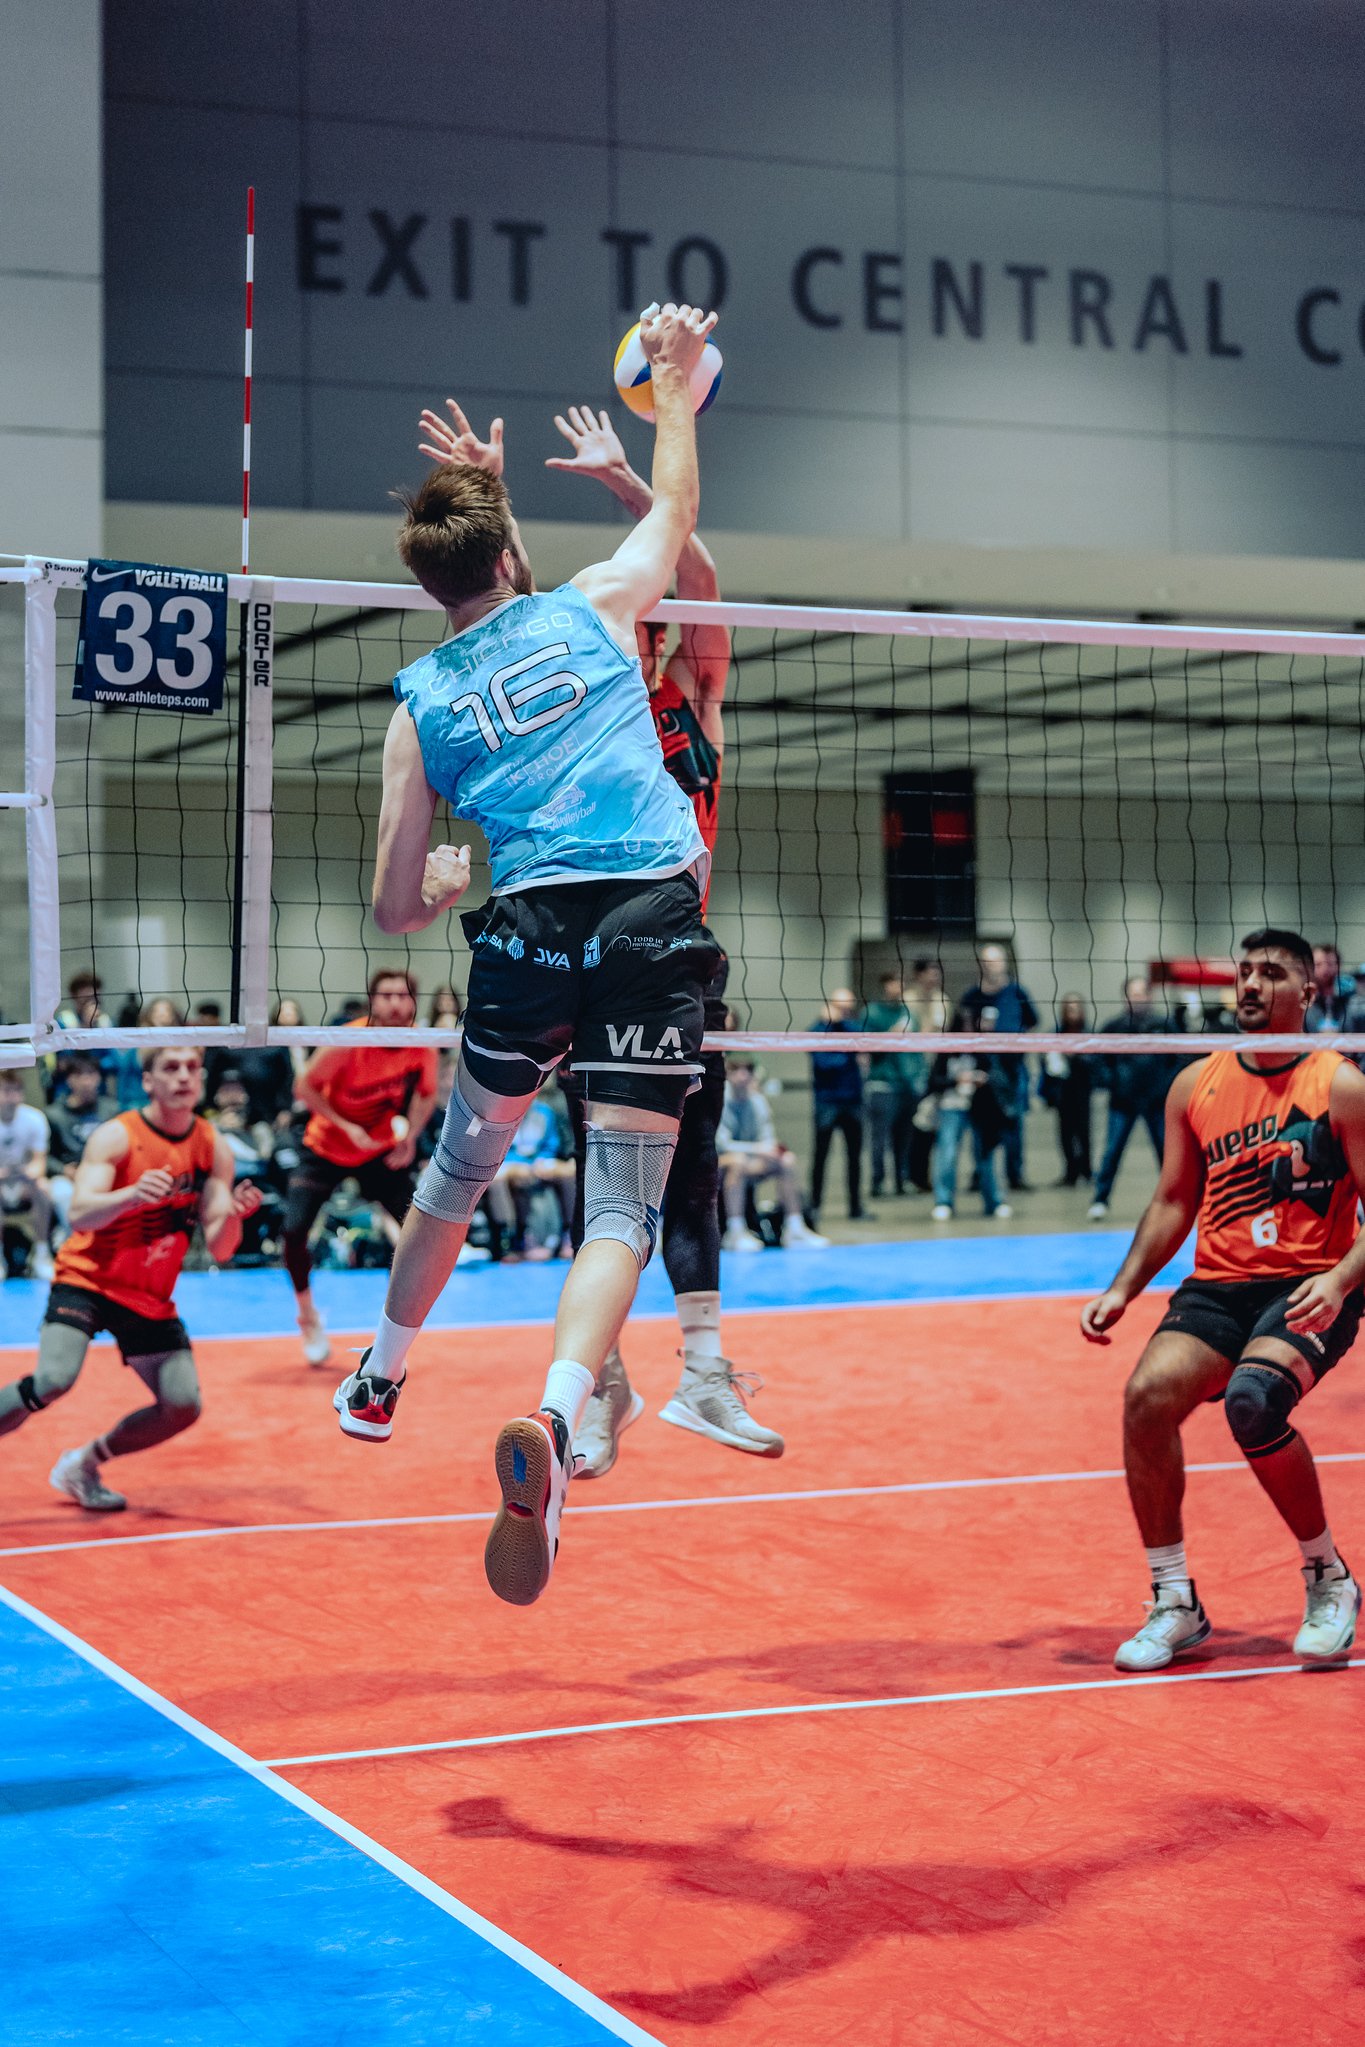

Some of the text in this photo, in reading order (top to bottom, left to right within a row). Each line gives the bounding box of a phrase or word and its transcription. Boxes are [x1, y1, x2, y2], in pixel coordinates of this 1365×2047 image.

[297, 203, 1365, 367] EXIT TO CENTRAL C
[53, 563, 85, 574] Senoh
[134, 568, 225, 593] VOLLEYBALL
[95, 590, 214, 690] 33
[427, 611, 574, 695] CHICAGO
[94, 688, 210, 708] www.athleteps.com
[449, 641, 589, 755] 16
[527, 759, 570, 787] GROUP
[533, 947, 571, 969] JVA
[605, 1024, 684, 1060] VLA
[1251, 1209, 1279, 1249] 6
